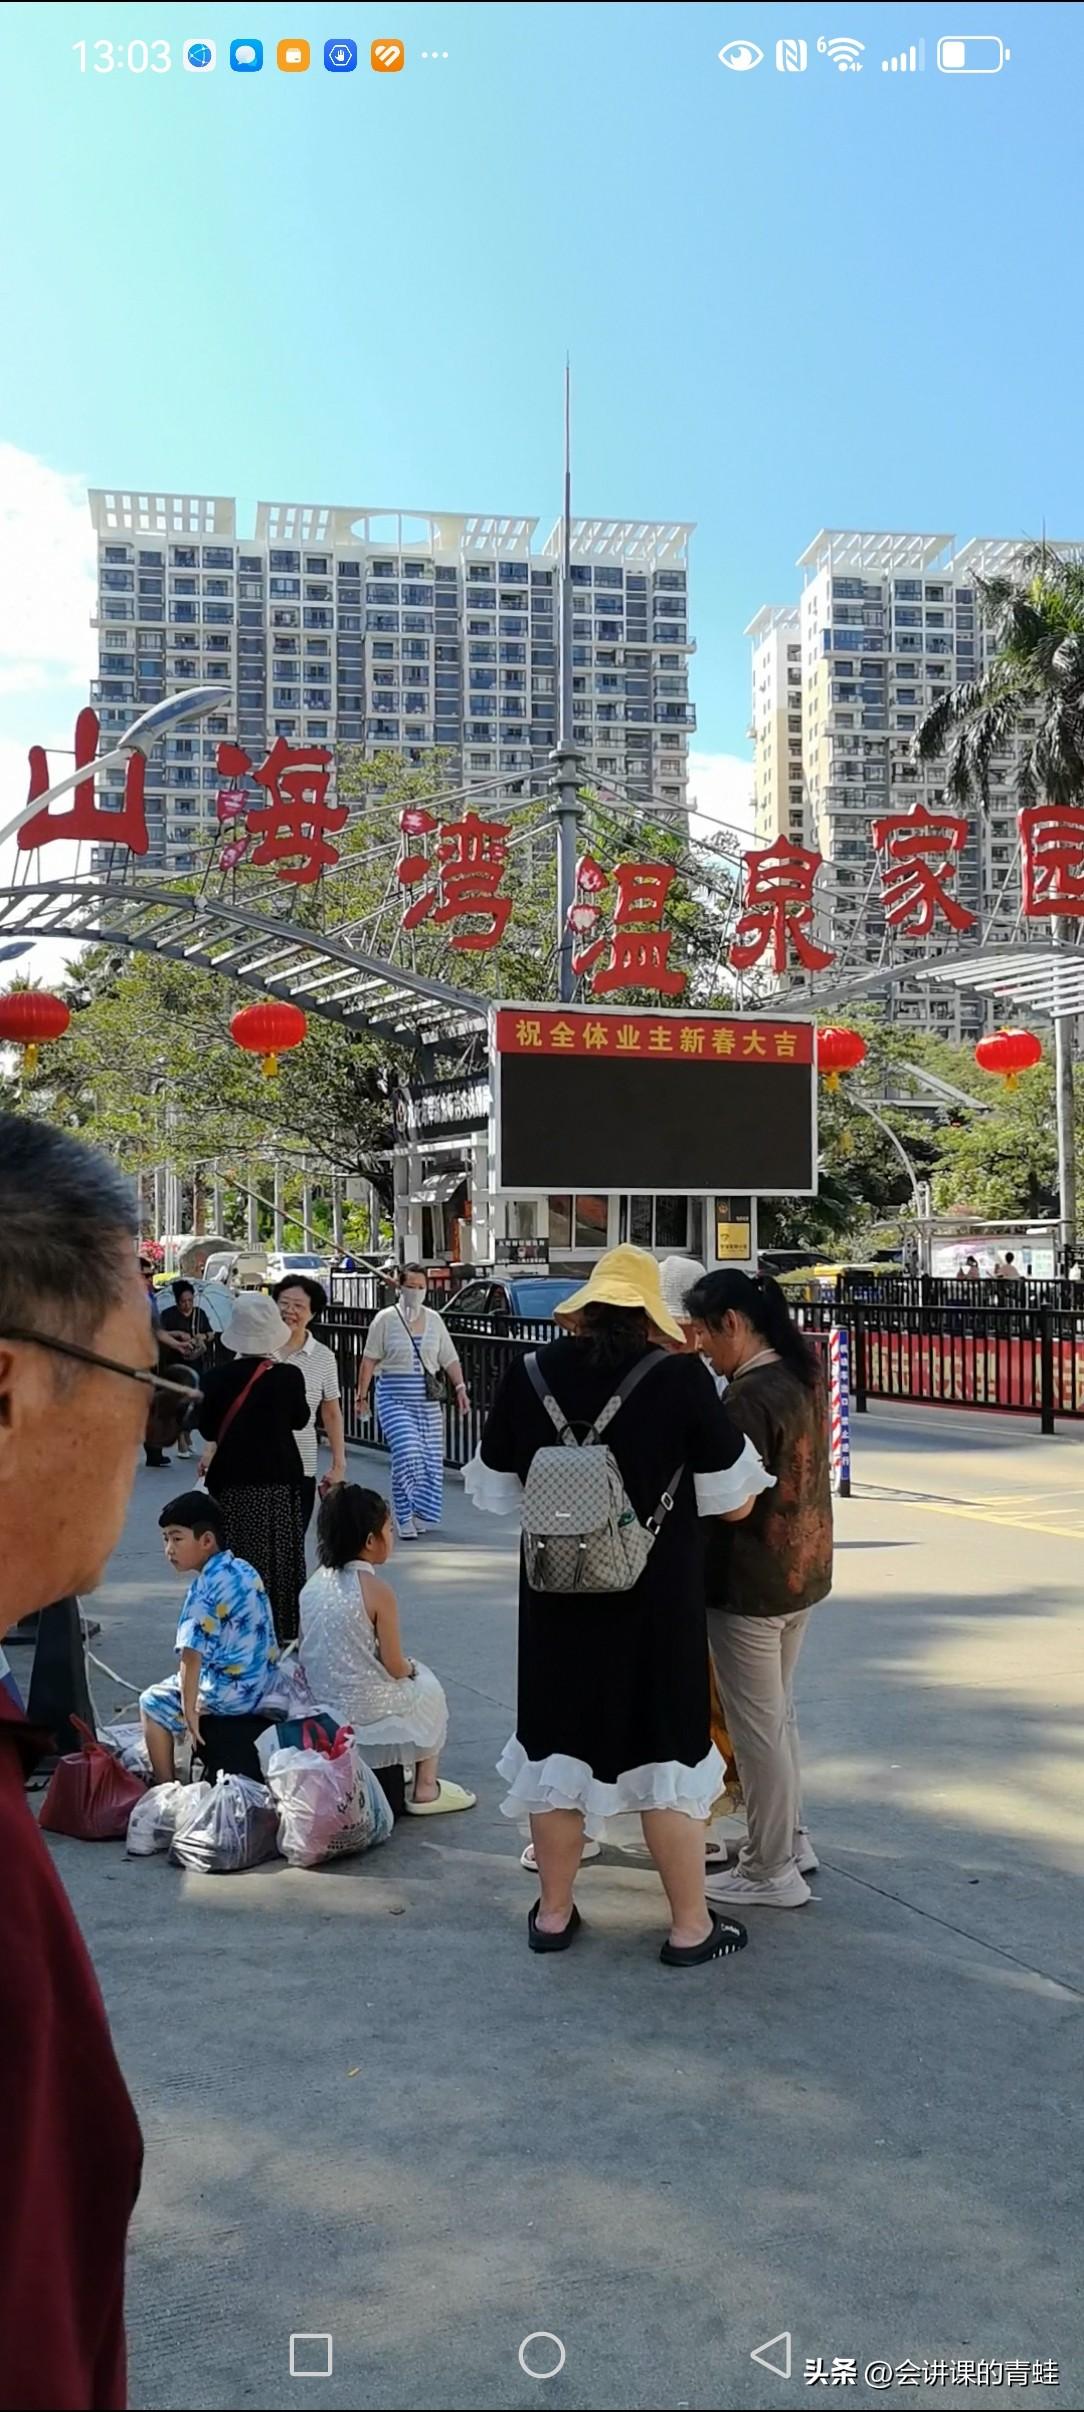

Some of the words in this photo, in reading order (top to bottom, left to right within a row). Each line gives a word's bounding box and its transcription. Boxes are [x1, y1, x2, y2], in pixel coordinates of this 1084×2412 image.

[17, 706, 1084, 996] 山海湾温泉家园
[515, 1018, 798, 1058] 祝全体业主新春大吉
